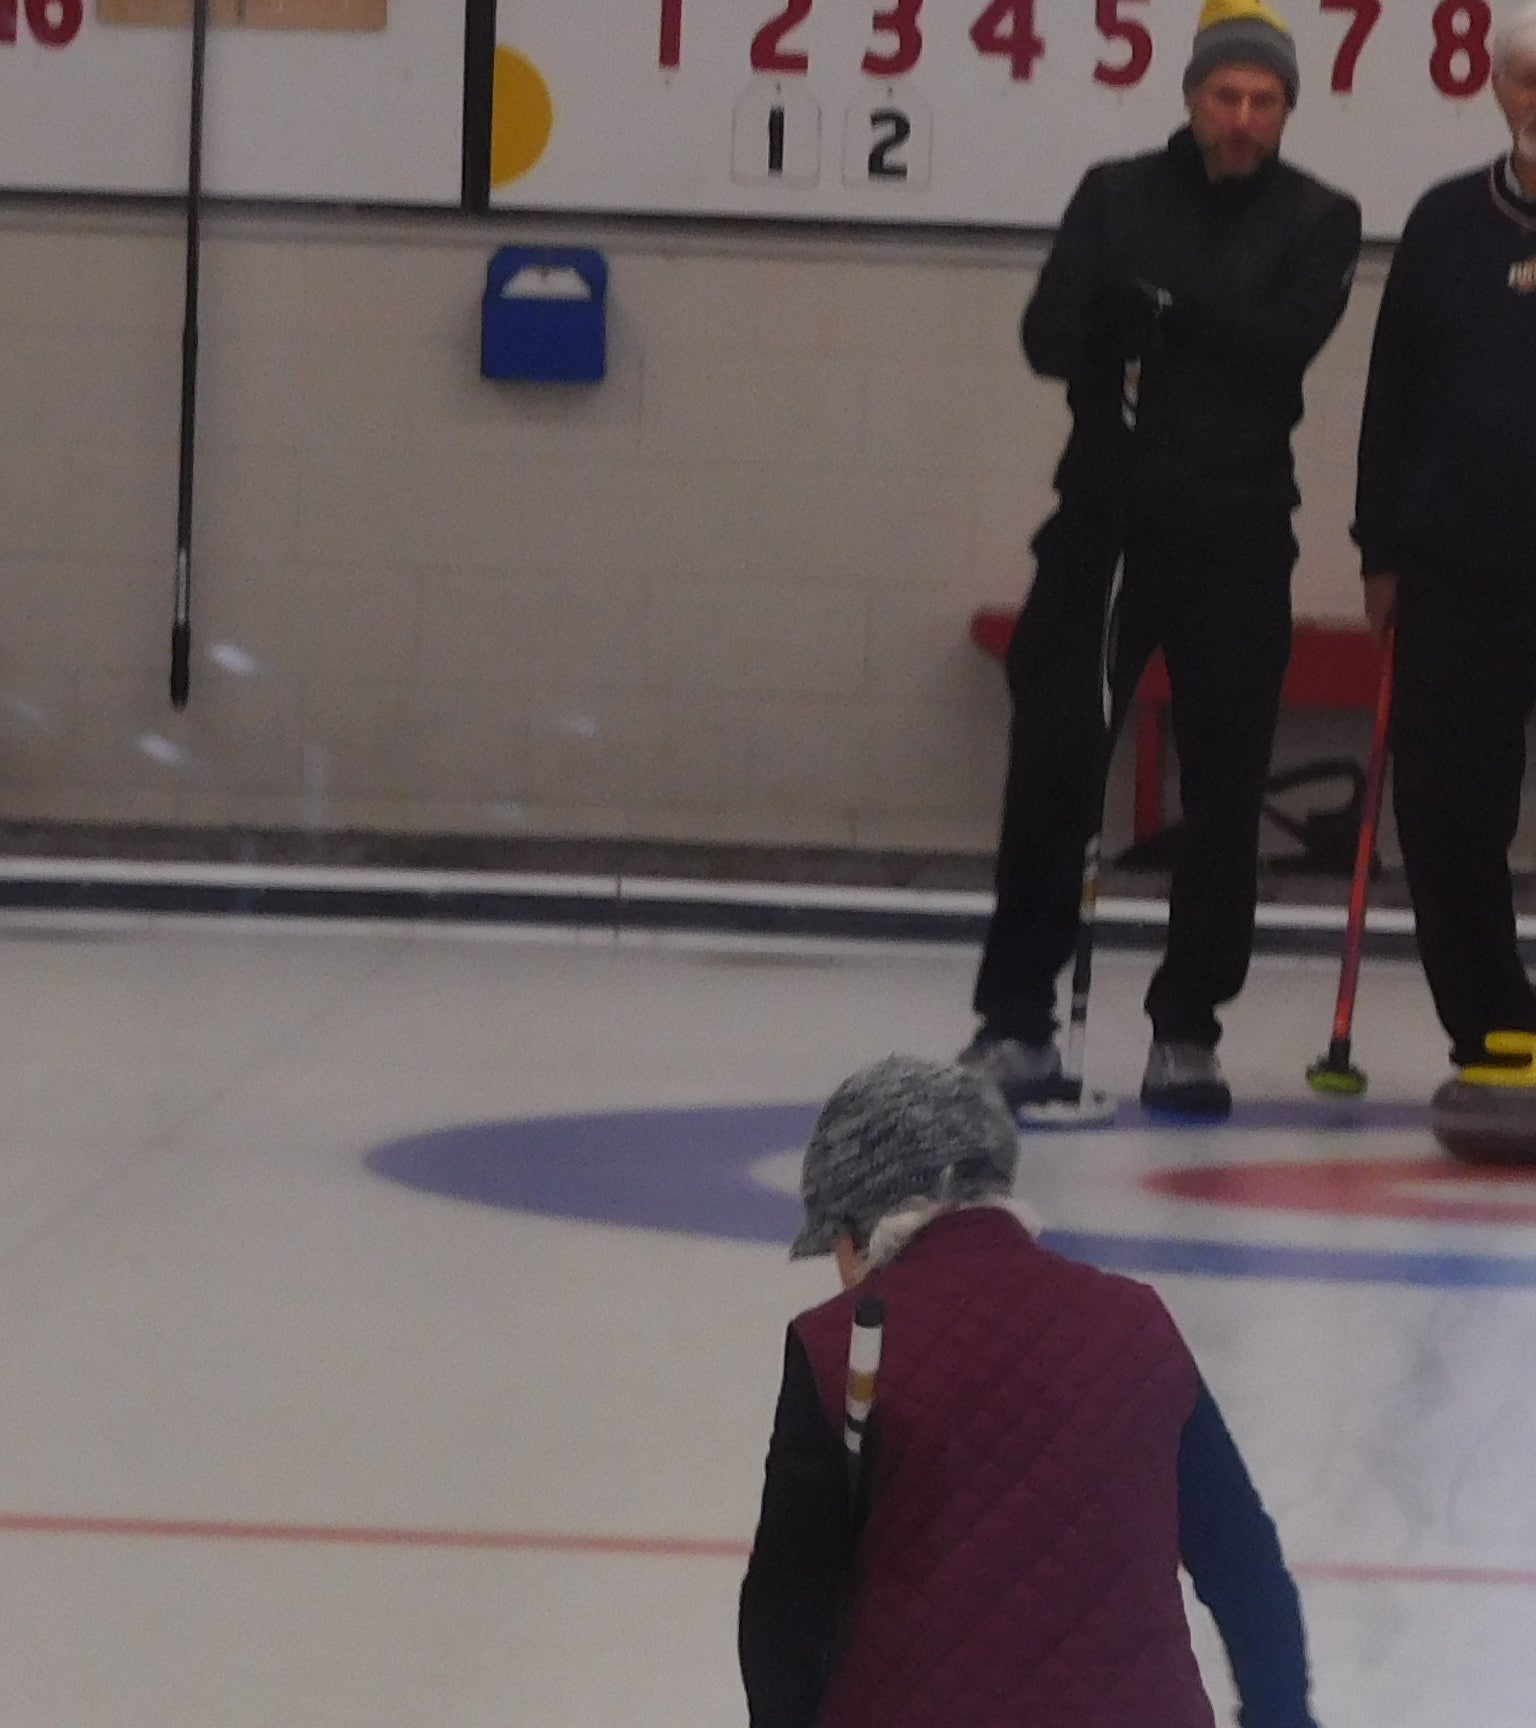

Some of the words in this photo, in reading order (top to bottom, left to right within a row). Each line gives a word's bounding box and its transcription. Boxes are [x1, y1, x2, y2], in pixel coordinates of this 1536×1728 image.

[659, 0, 683, 69] 1
[750, 0, 813, 75] 2
[861, 0, 924, 77] 3
[971, 0, 1045, 80] 4
[1094, 0, 1154, 88] 5
[1321, 0, 1383, 94] 7
[1429, 0, 1492, 99] 8
[768, 105, 785, 177] 1
[867, 108, 911, 180] 2
